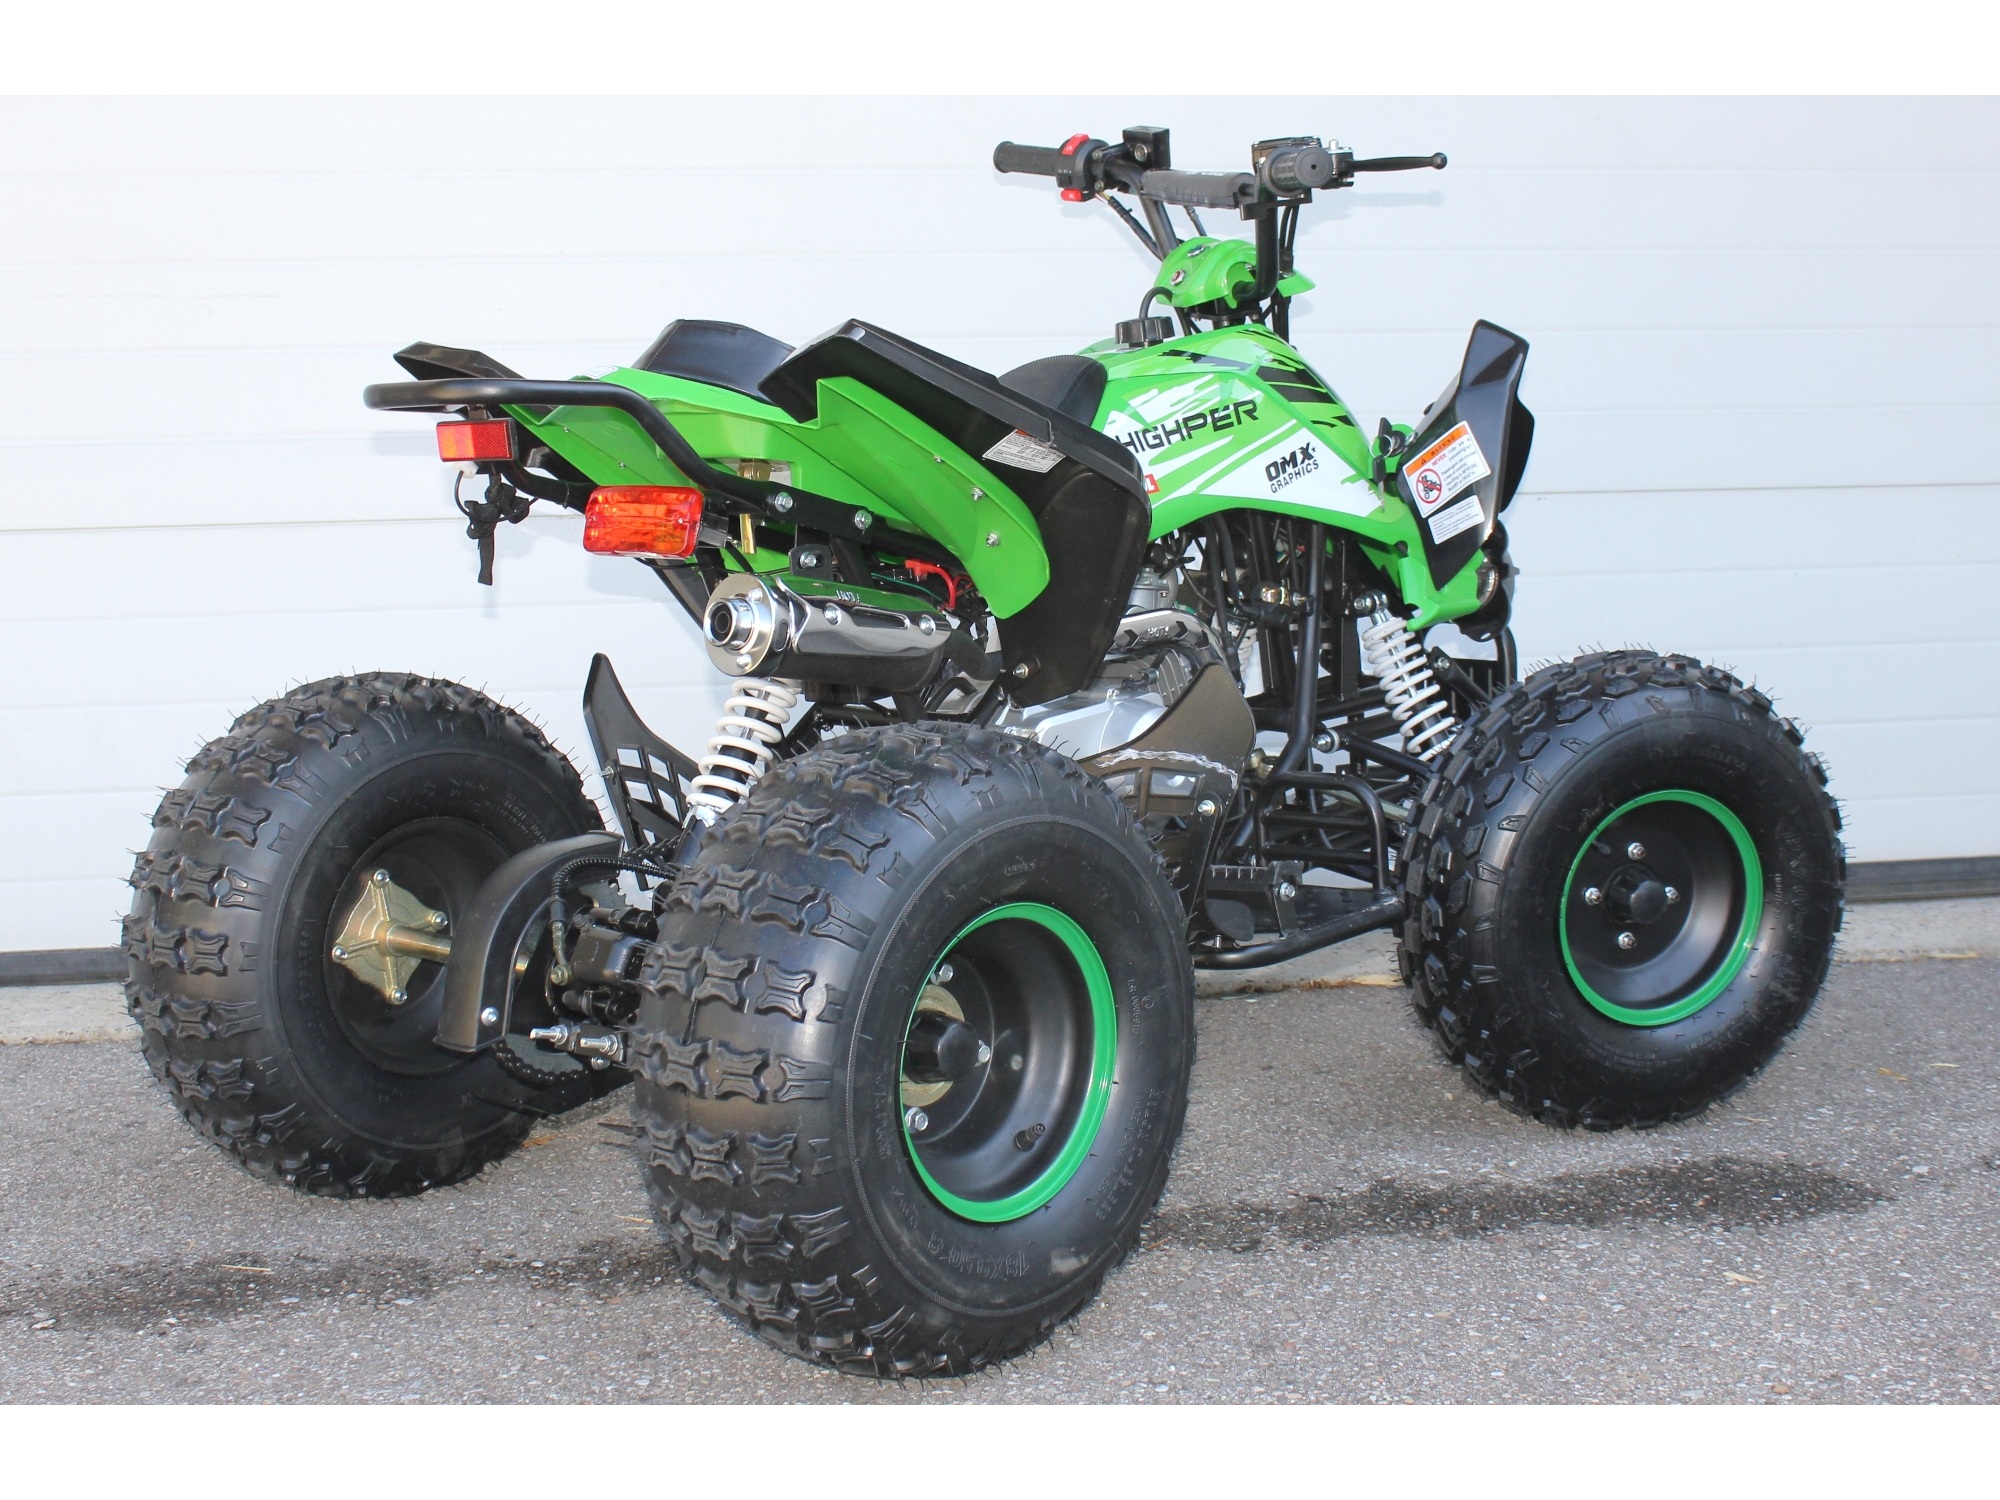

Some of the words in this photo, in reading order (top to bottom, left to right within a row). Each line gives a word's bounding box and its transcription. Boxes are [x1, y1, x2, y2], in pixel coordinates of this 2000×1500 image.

[1115, 400, 1259, 453] HIGHPER
[1265, 441, 1315, 482] OMX
[1430, 435, 1456, 456] WARNING
[1431, 453, 1447, 466] NEVER
[1270, 459, 1320, 494] GRAPHICS
